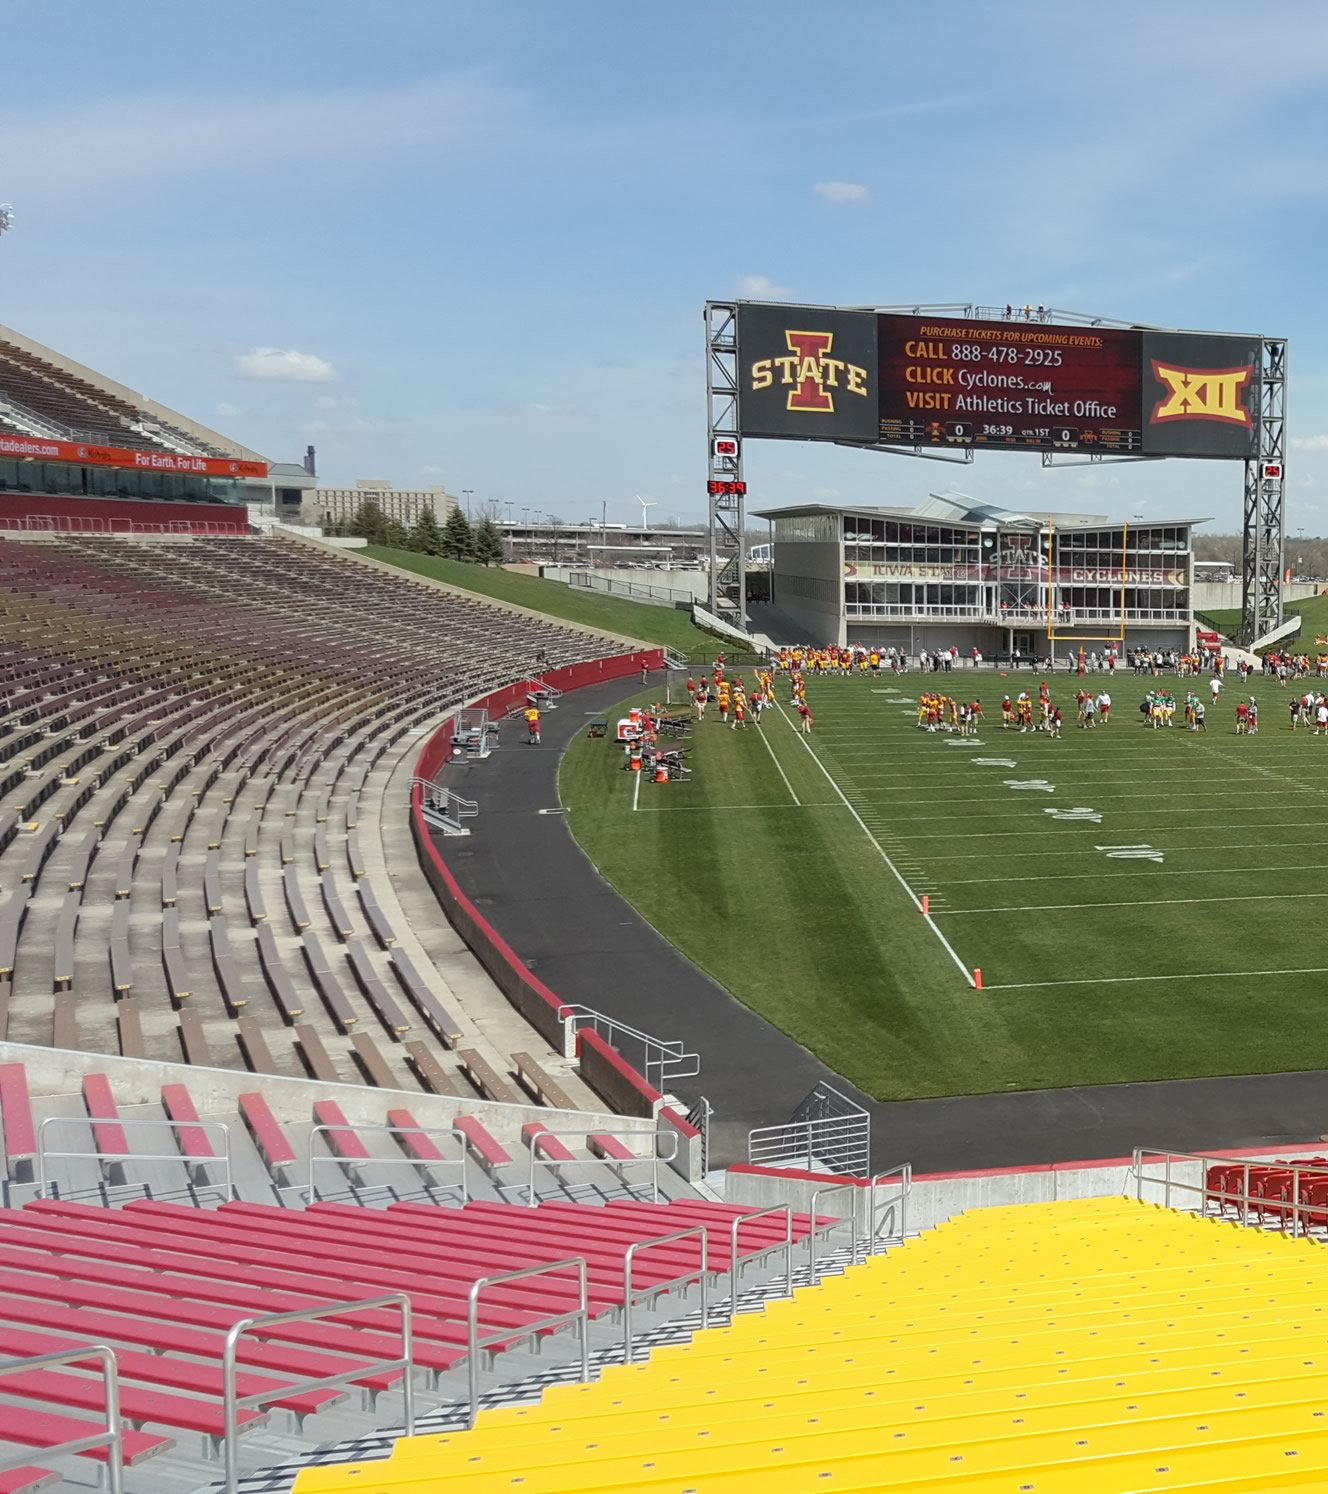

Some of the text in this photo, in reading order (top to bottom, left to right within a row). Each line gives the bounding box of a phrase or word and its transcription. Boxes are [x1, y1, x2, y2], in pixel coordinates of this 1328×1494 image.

[920, 326, 1103, 347] PURCHASE TICKETS FOR UPCOMING EVENTS:
[905, 340, 1063, 366] CALL 888-478-2925
[752, 356, 867, 397] STATE
[905, 366, 1056, 395] CLICK Cyclones.com
[1157, 367, 1247, 421] XII
[906, 391, 1117, 418] VISIT Athletics Ticket Office
[955, 424, 963, 436] 0
[983, 425, 1013, 435] 36:39
[1035, 428, 1050, 436] 1ST
[1062, 430, 1070, 441] 0
[719, 442, 734, 454] 25
[136, 453, 207, 471] For Earth, For Life
[1266, 466, 1278, 477] 25
[711, 481, 745, 494] 36:39
[989, 550, 1048, 568] STATE
[873, 564, 967, 577] IOWA STATE
[1073, 569, 1163, 582] CYCLONES
